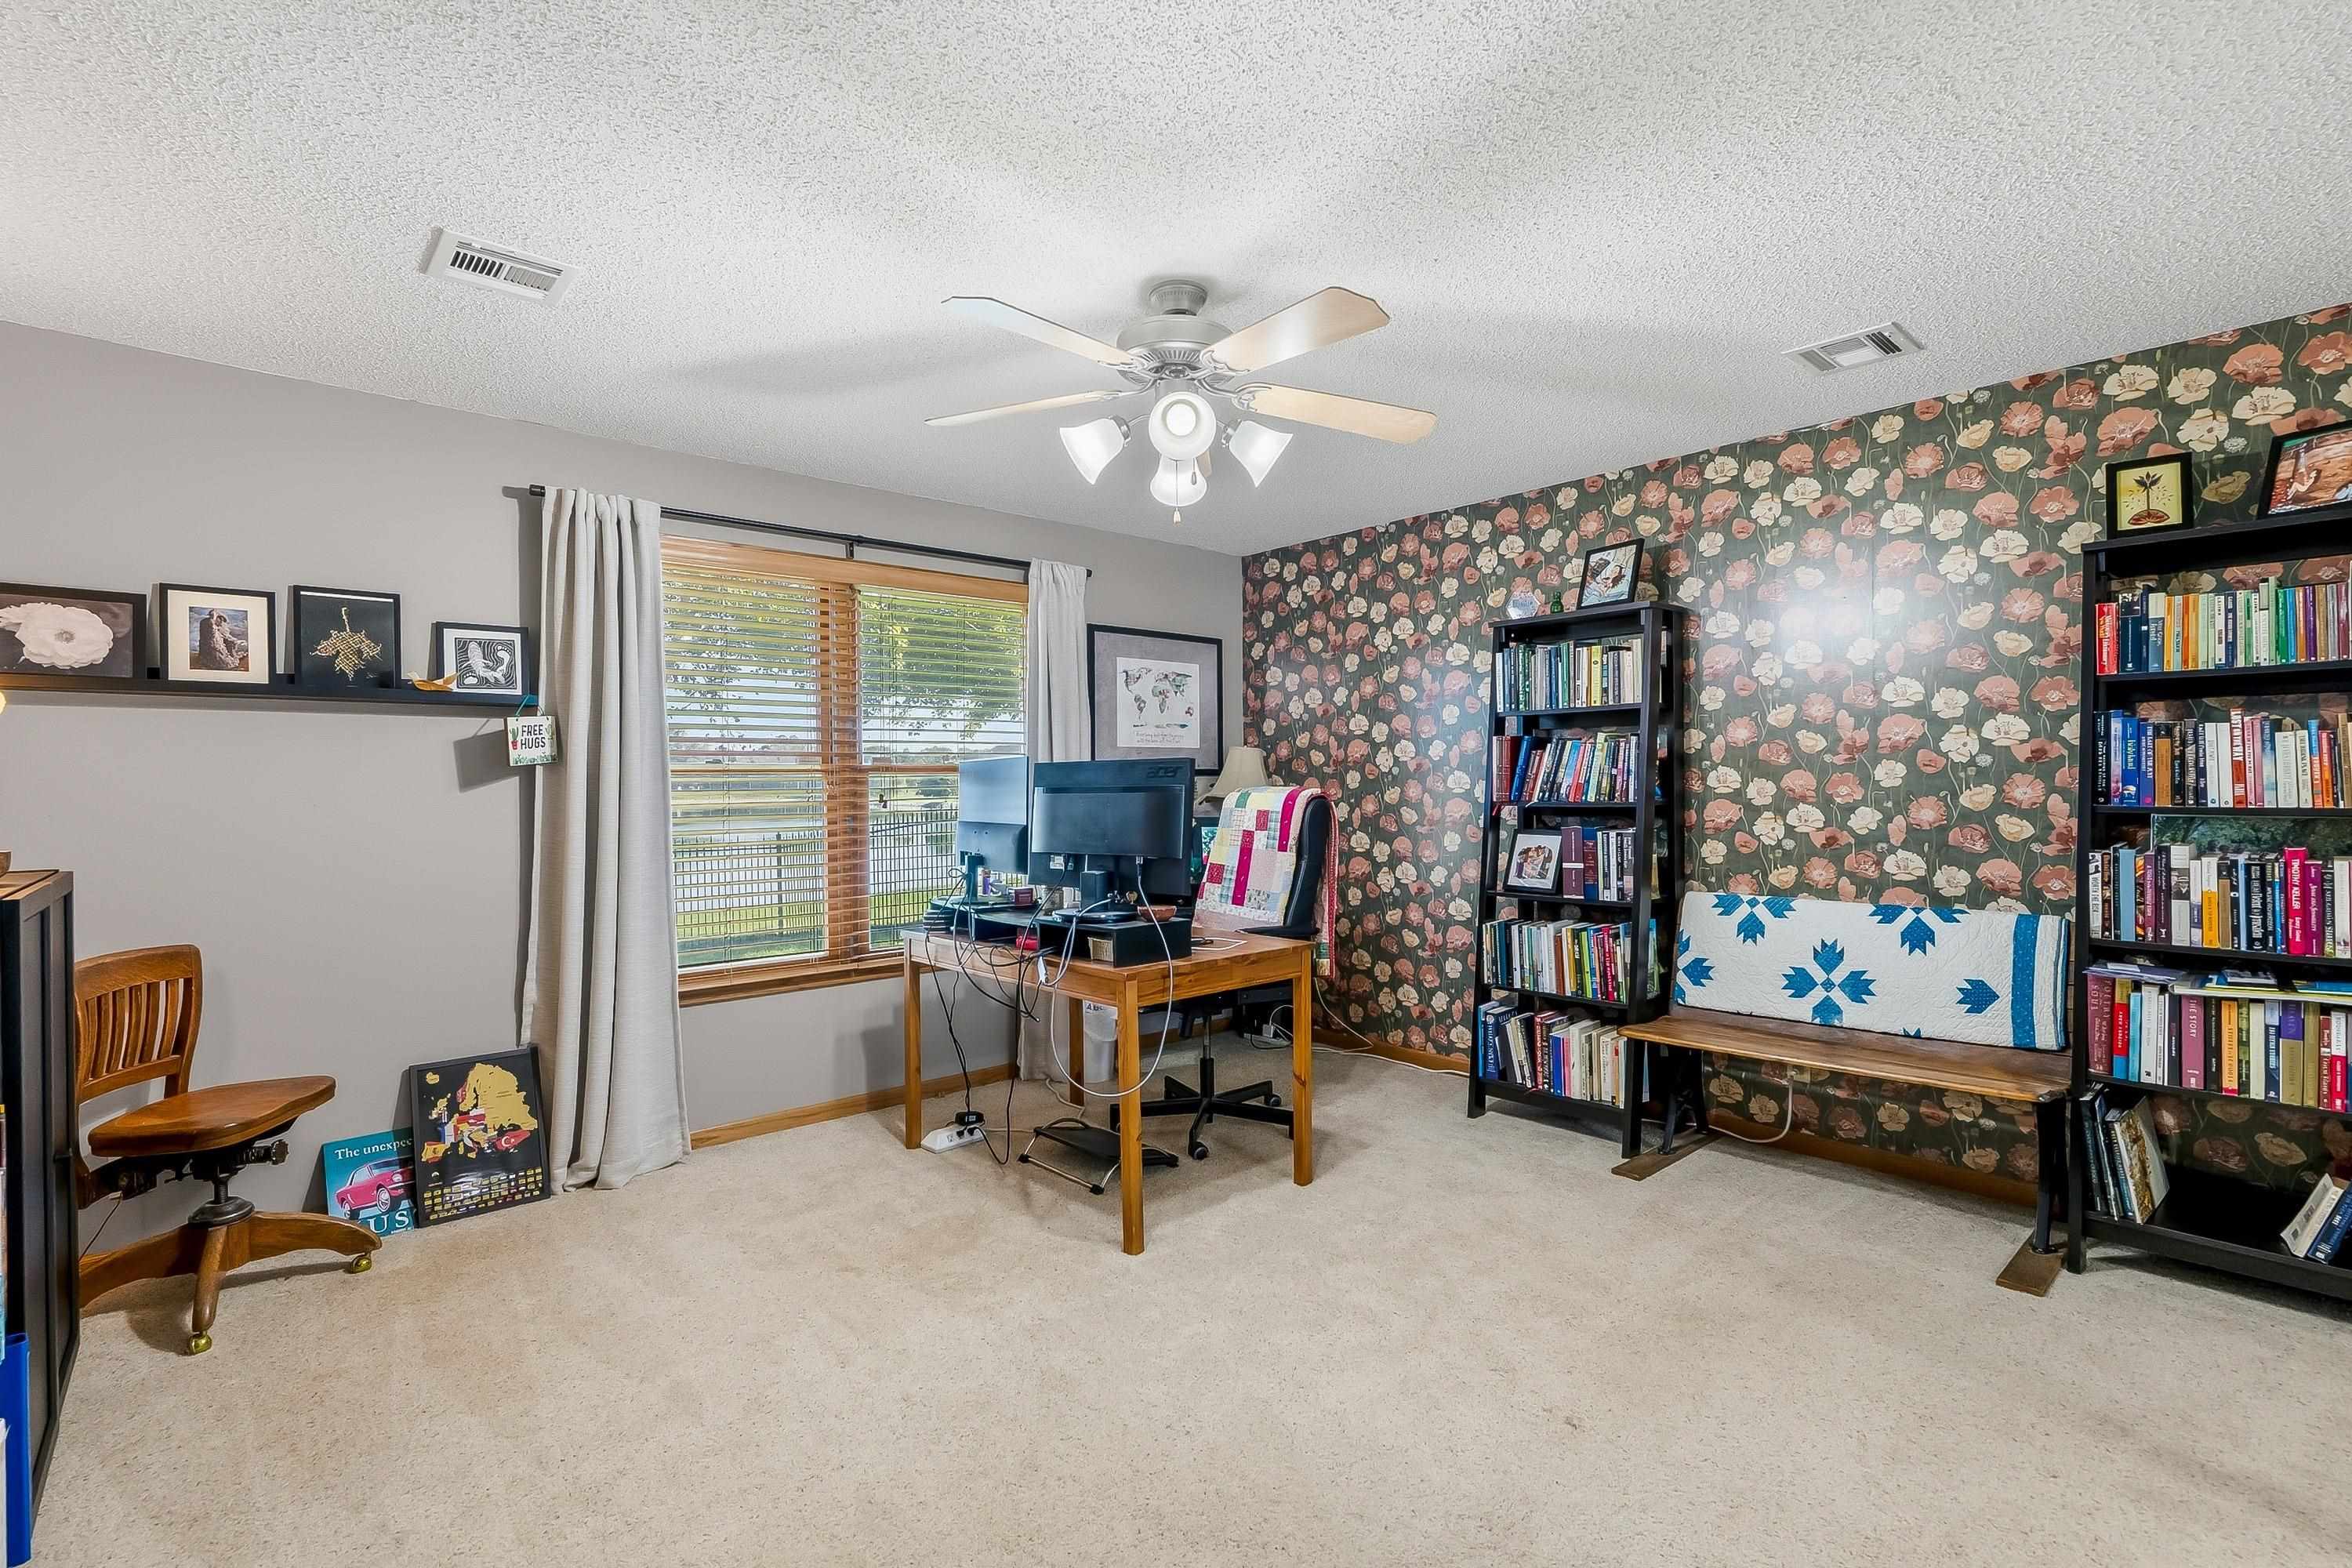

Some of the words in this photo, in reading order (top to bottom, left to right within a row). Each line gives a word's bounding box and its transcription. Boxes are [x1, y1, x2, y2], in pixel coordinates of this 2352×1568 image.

[2230, 710, 2242, 728] LOST
[521, 724, 543, 737] FREE
[520, 737, 546, 750] HUGS
[1147, 766, 1185, 779] acer
[2292, 858, 2300, 885] TIMOTHY
[2292, 887, 2300, 909] KELLER
[2189, 999, 2198, 1012] THE
[2189, 1015, 2198, 1037] STORY
[334, 1148, 360, 1160] The
[367, 1210, 409, 1233] US
